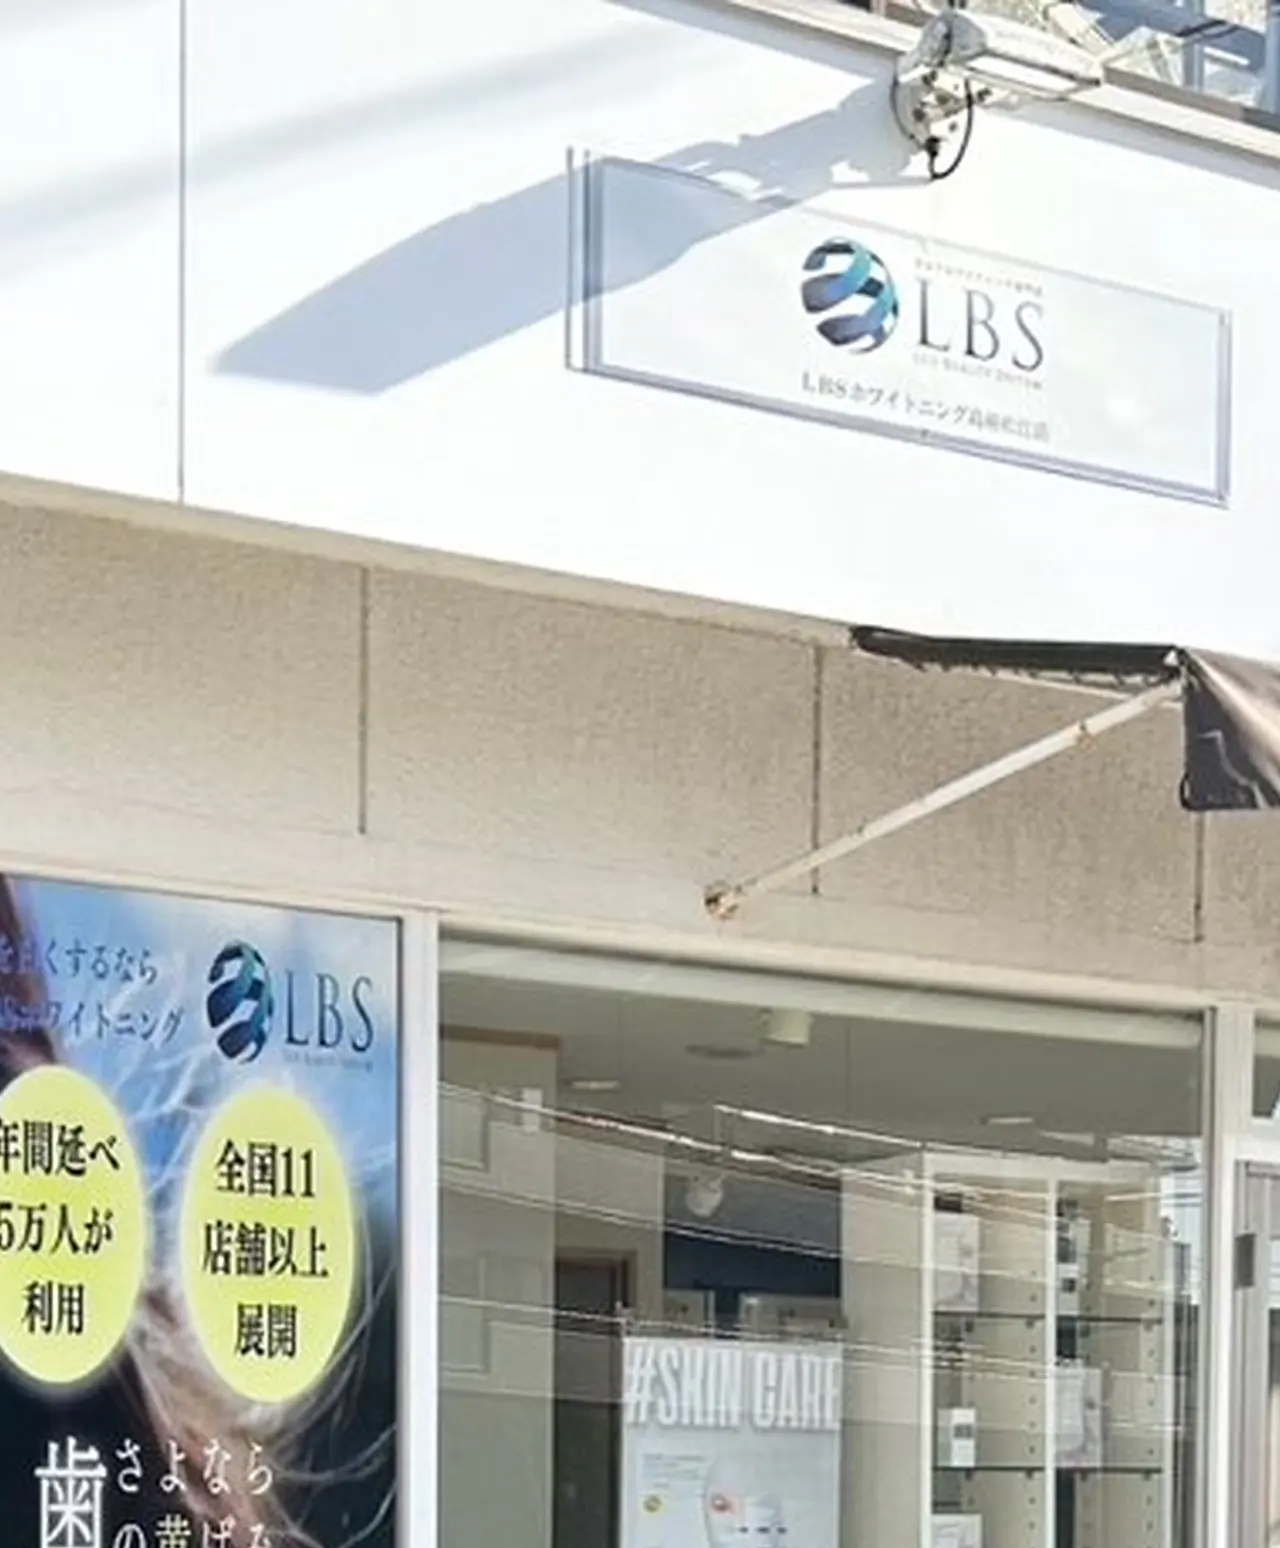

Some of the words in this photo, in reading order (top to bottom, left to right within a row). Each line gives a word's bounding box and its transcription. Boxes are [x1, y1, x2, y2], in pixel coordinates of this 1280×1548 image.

[917, 278, 1045, 373] LBS
[284, 968, 374, 1053] LBS
[216, 1139, 316, 1199] 全国11
[203, 1219, 329, 1279] 店舗以上
[21, 1281, 85, 1336] 利用
[235, 1303, 298, 1359] 展開
[116, 1438, 273, 1495] さよなら
